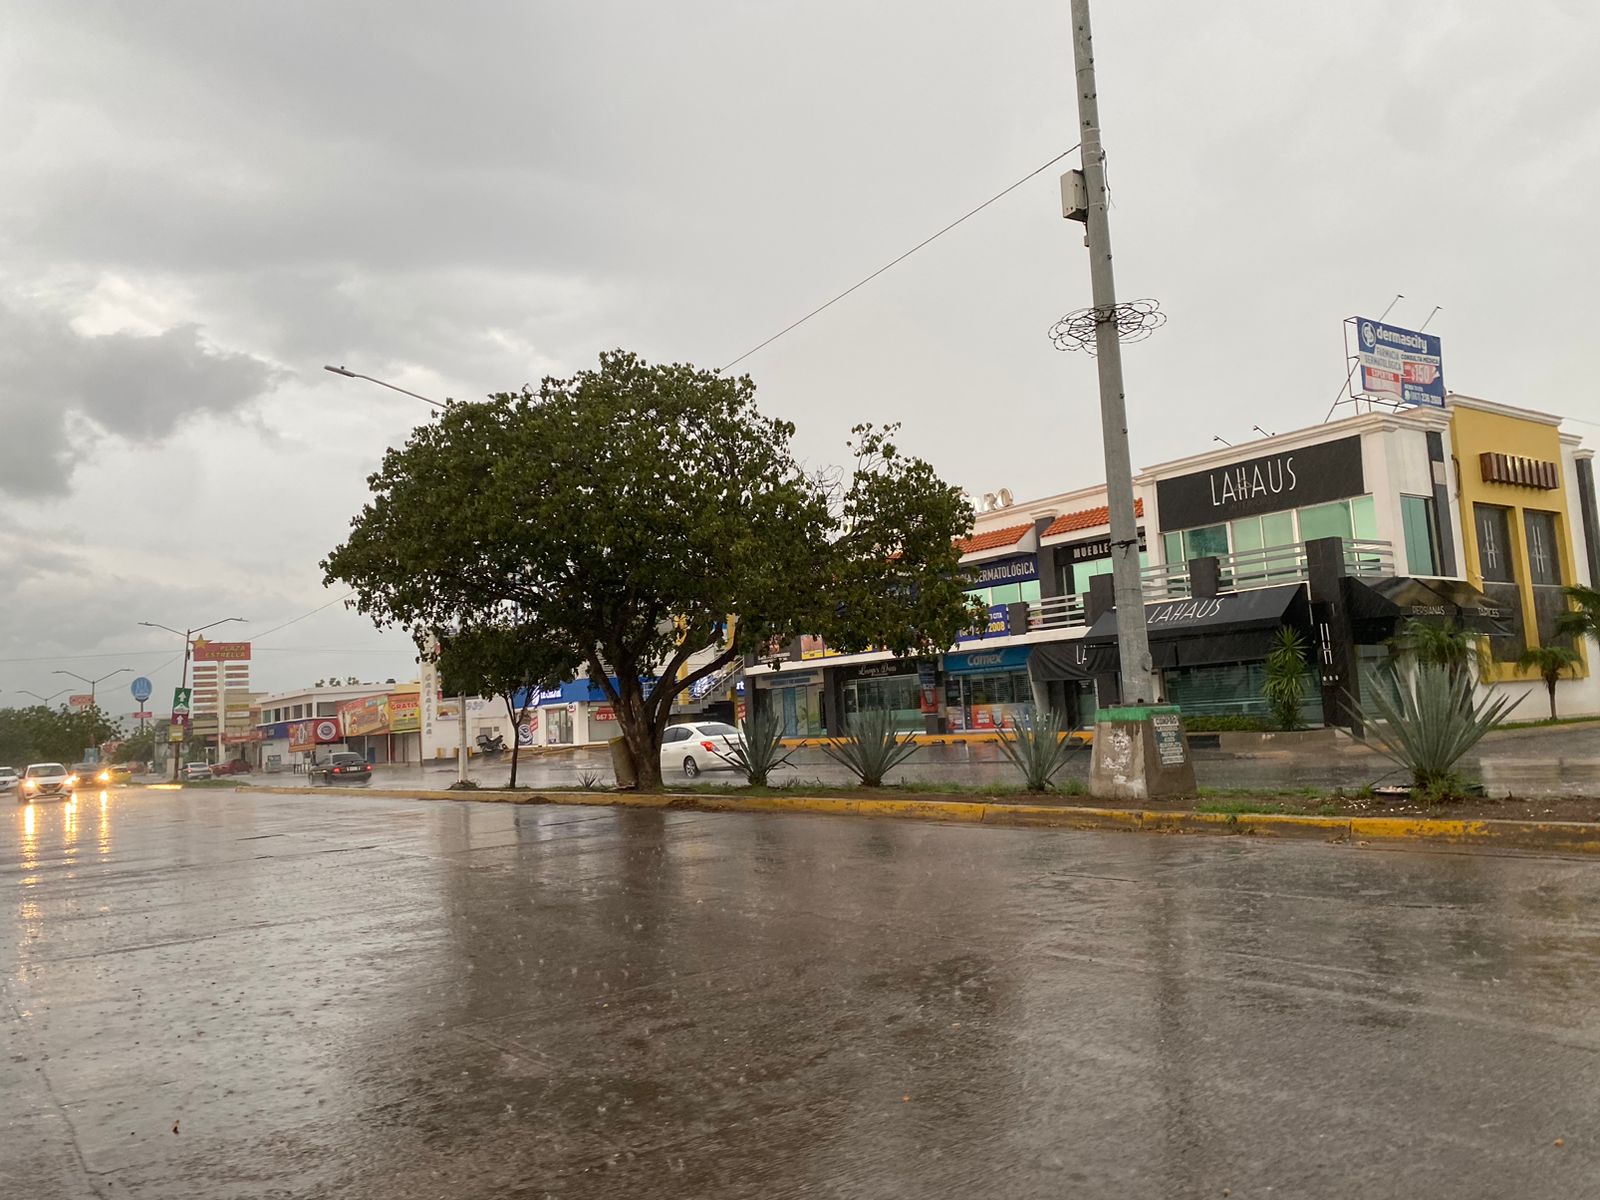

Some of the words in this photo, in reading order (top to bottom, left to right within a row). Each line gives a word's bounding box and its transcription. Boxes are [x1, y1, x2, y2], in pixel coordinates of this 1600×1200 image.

[1210, 457, 1296, 506] LAHAUS
[1073, 541, 1111, 559] MUEBLE
[975, 561, 1035, 583] ERMATOLÓGICA
[1147, 597, 1225, 624] LAHAUS
[967, 650, 1004, 667] Comex
[391, 702, 419, 711] GRATIS
